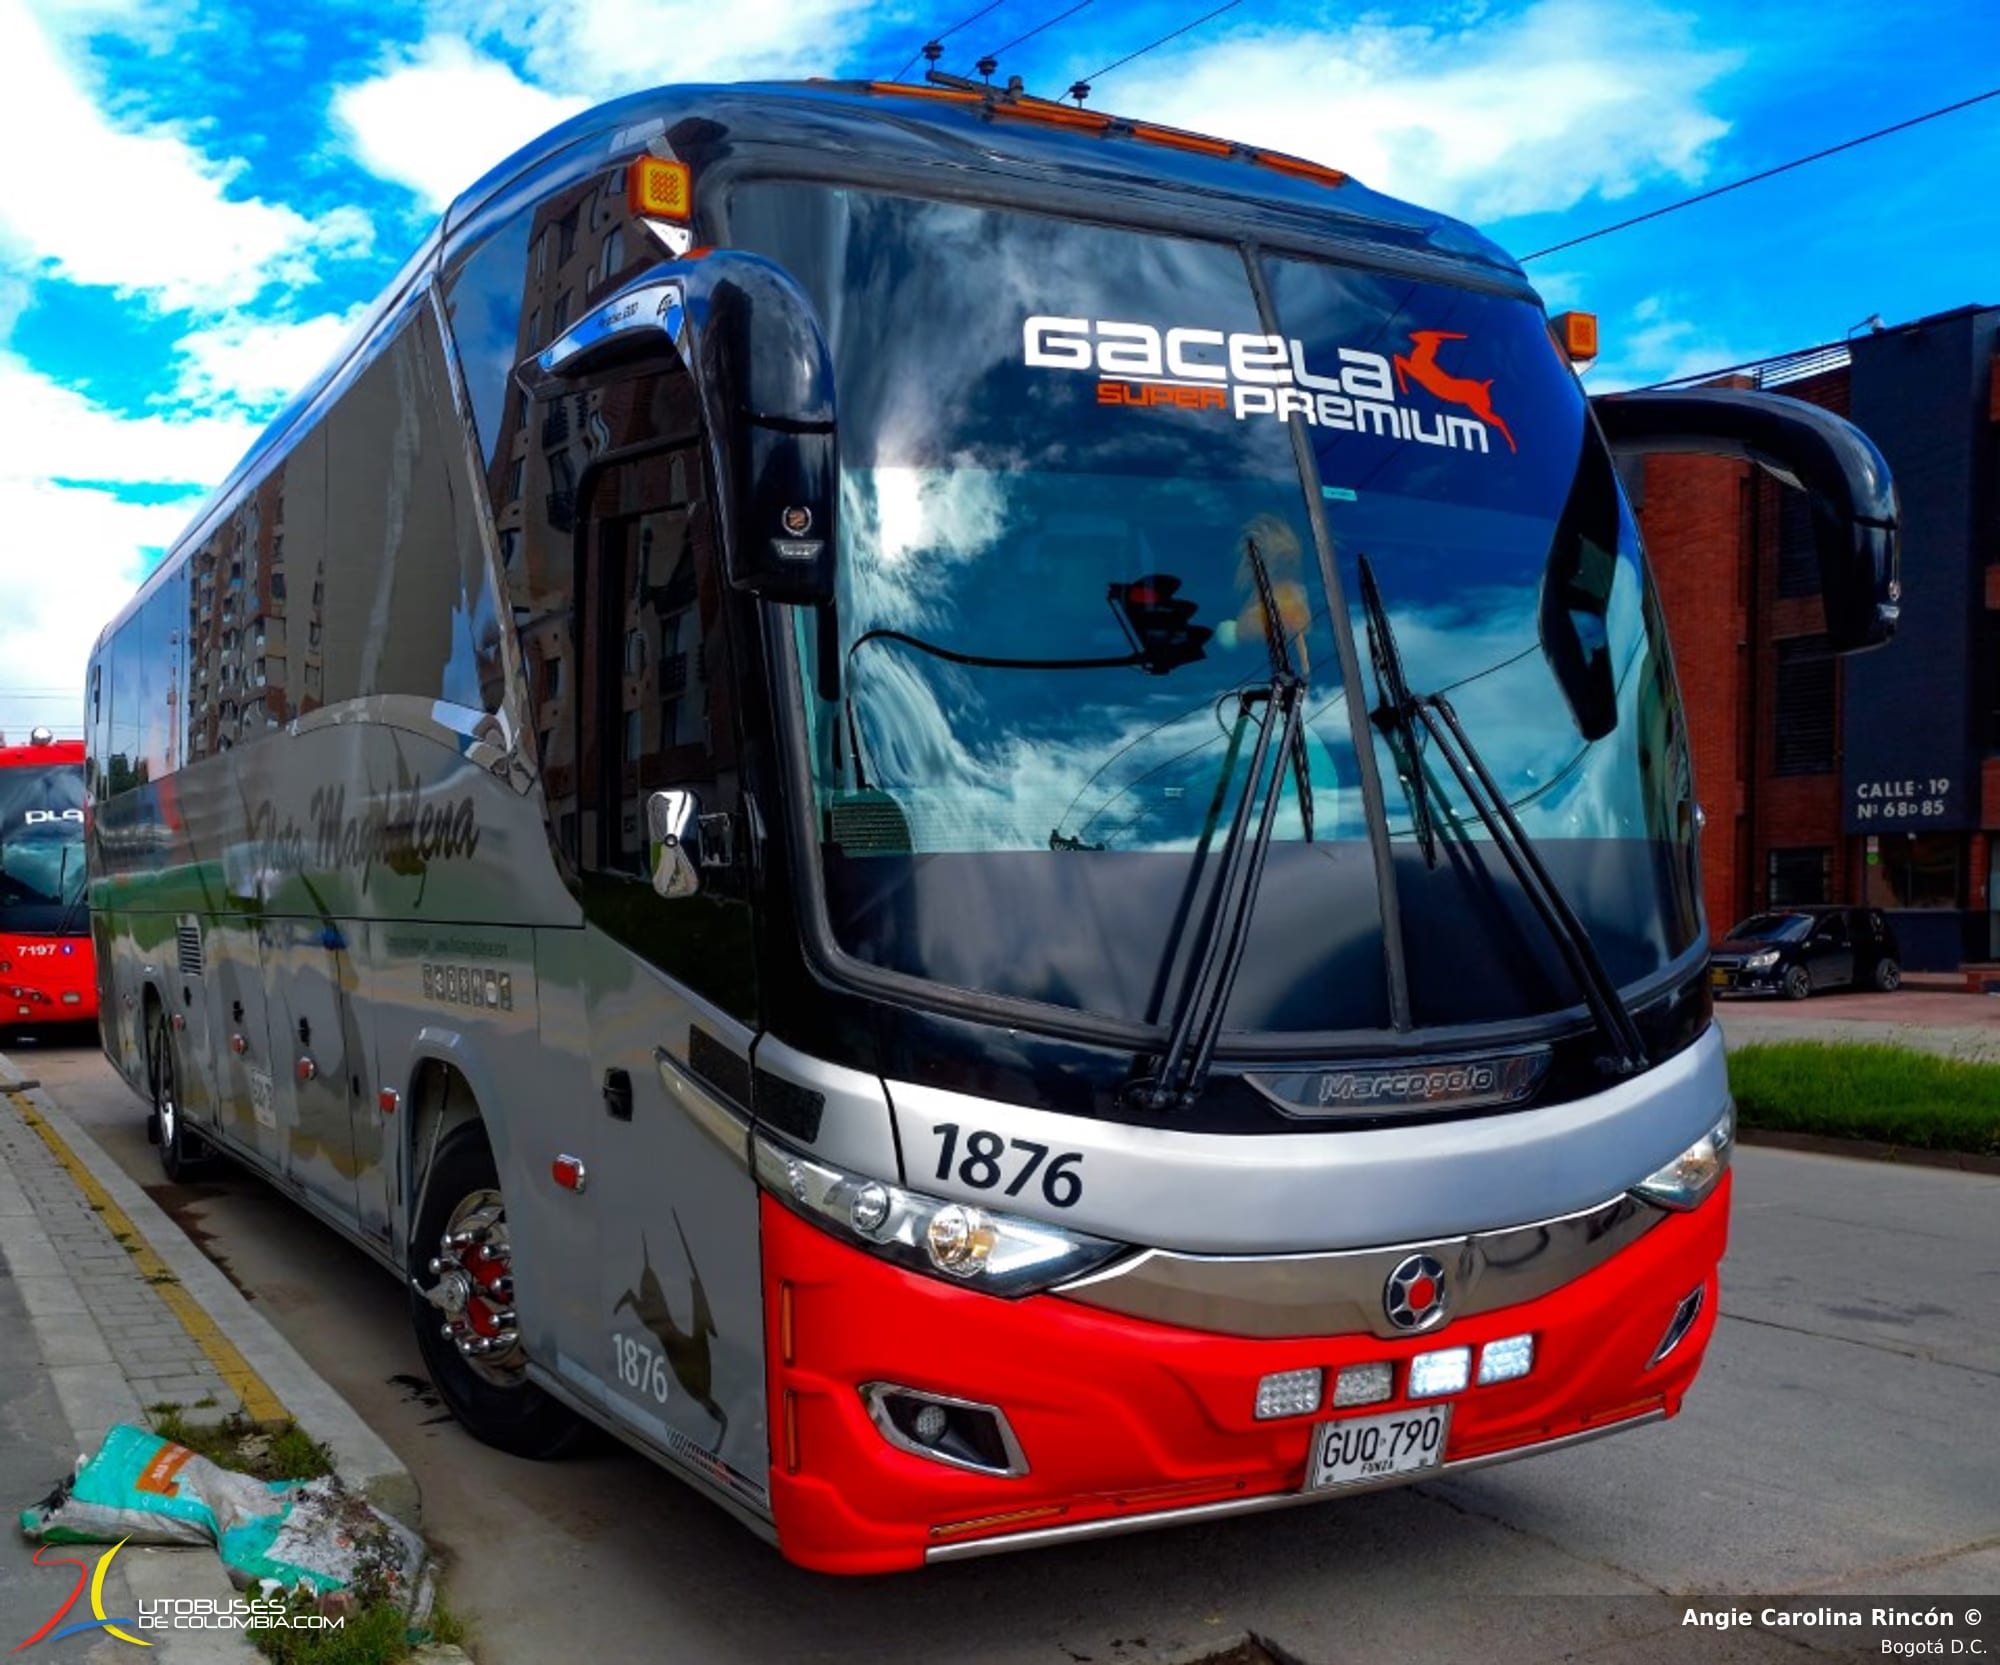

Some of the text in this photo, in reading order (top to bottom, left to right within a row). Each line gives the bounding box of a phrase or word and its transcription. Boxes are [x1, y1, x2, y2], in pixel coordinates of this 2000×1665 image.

[1856, 778, 1950, 799] CALLE 19
[17, 943, 57, 957] 7197
[1318, 1065, 1493, 1102] Marcopolo
[932, 1122, 1084, 1208] 1876
[612, 1332, 669, 1404] 1876
